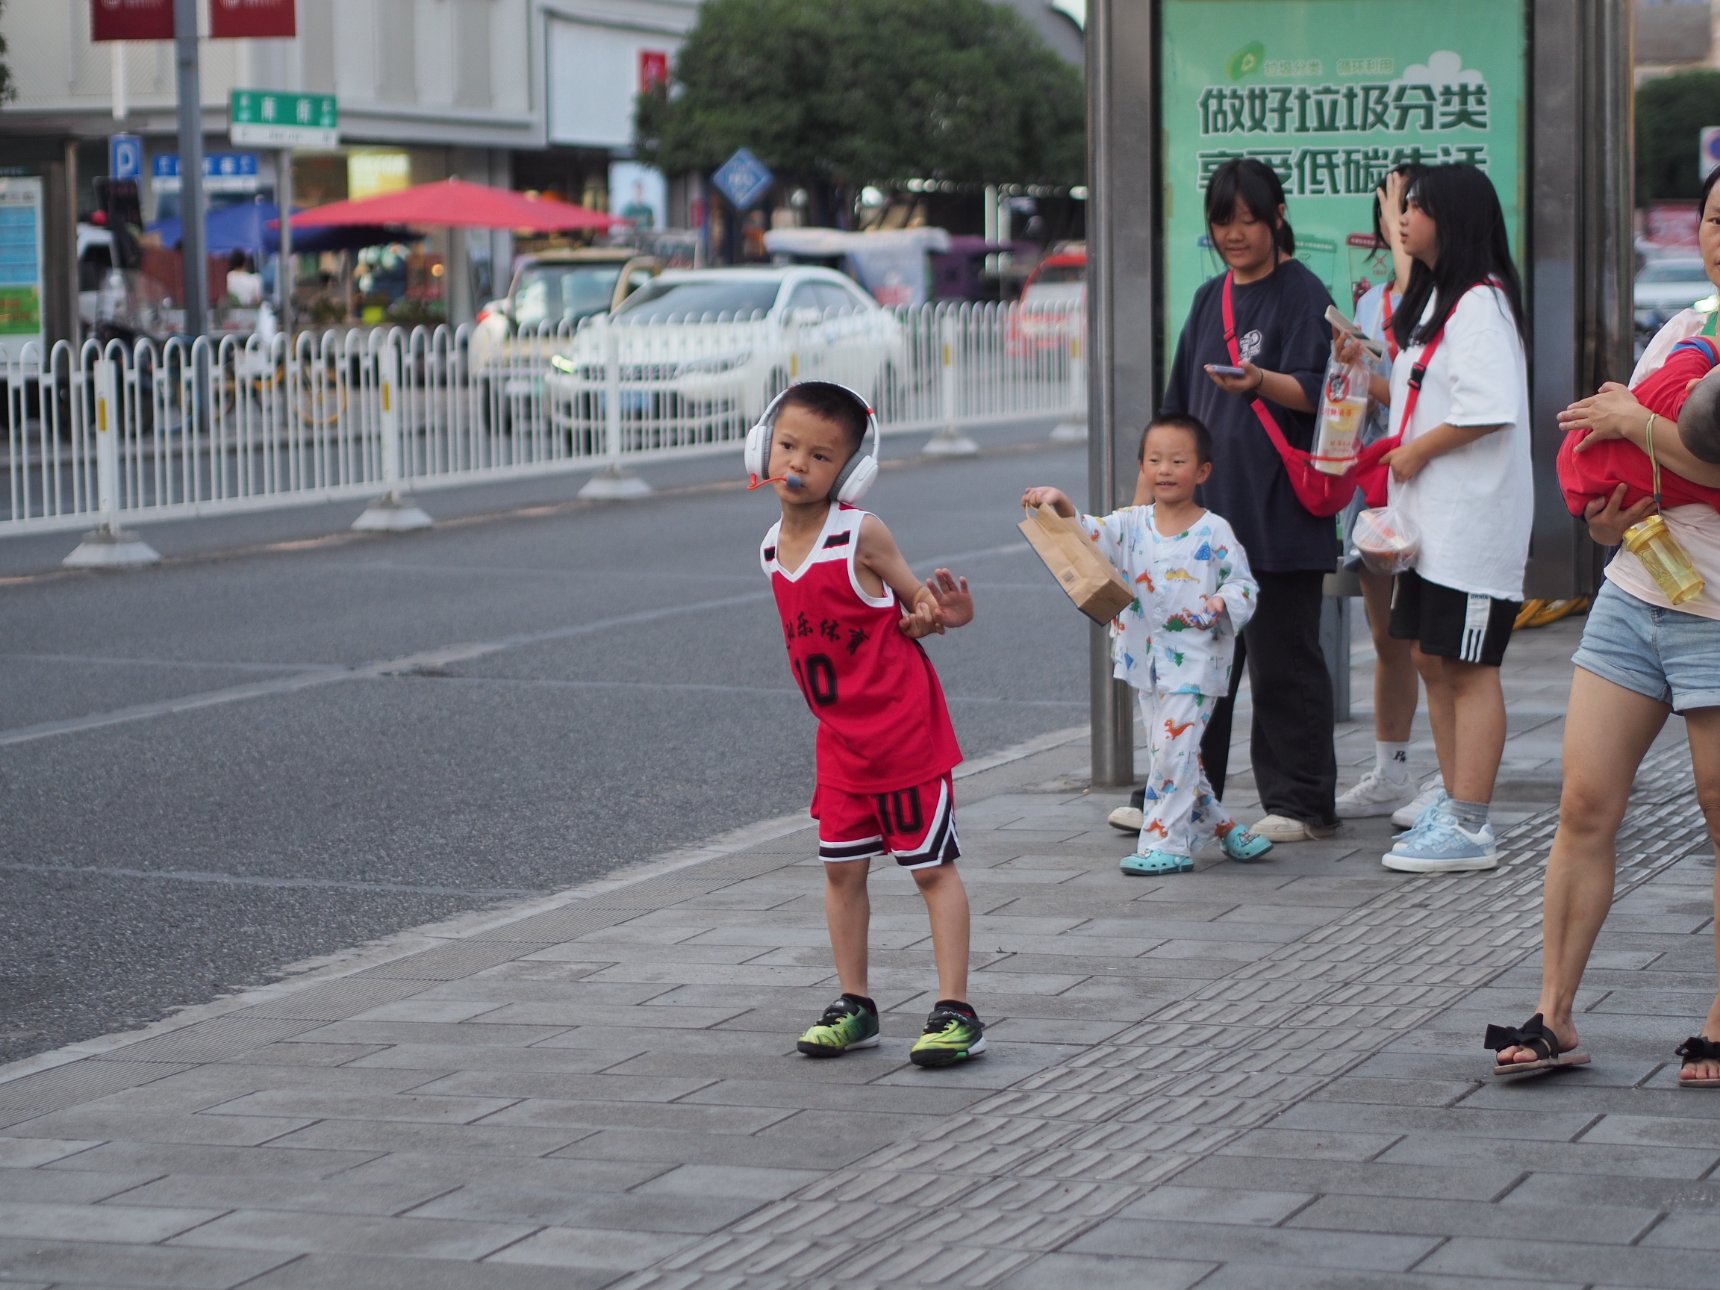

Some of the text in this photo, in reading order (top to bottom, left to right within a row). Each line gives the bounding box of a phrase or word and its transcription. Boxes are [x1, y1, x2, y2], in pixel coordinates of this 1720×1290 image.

[1198, 82, 1489, 135] 做好垃圾分类
[795, 653, 838, 709] 10
[874, 786, 922, 835] 10
